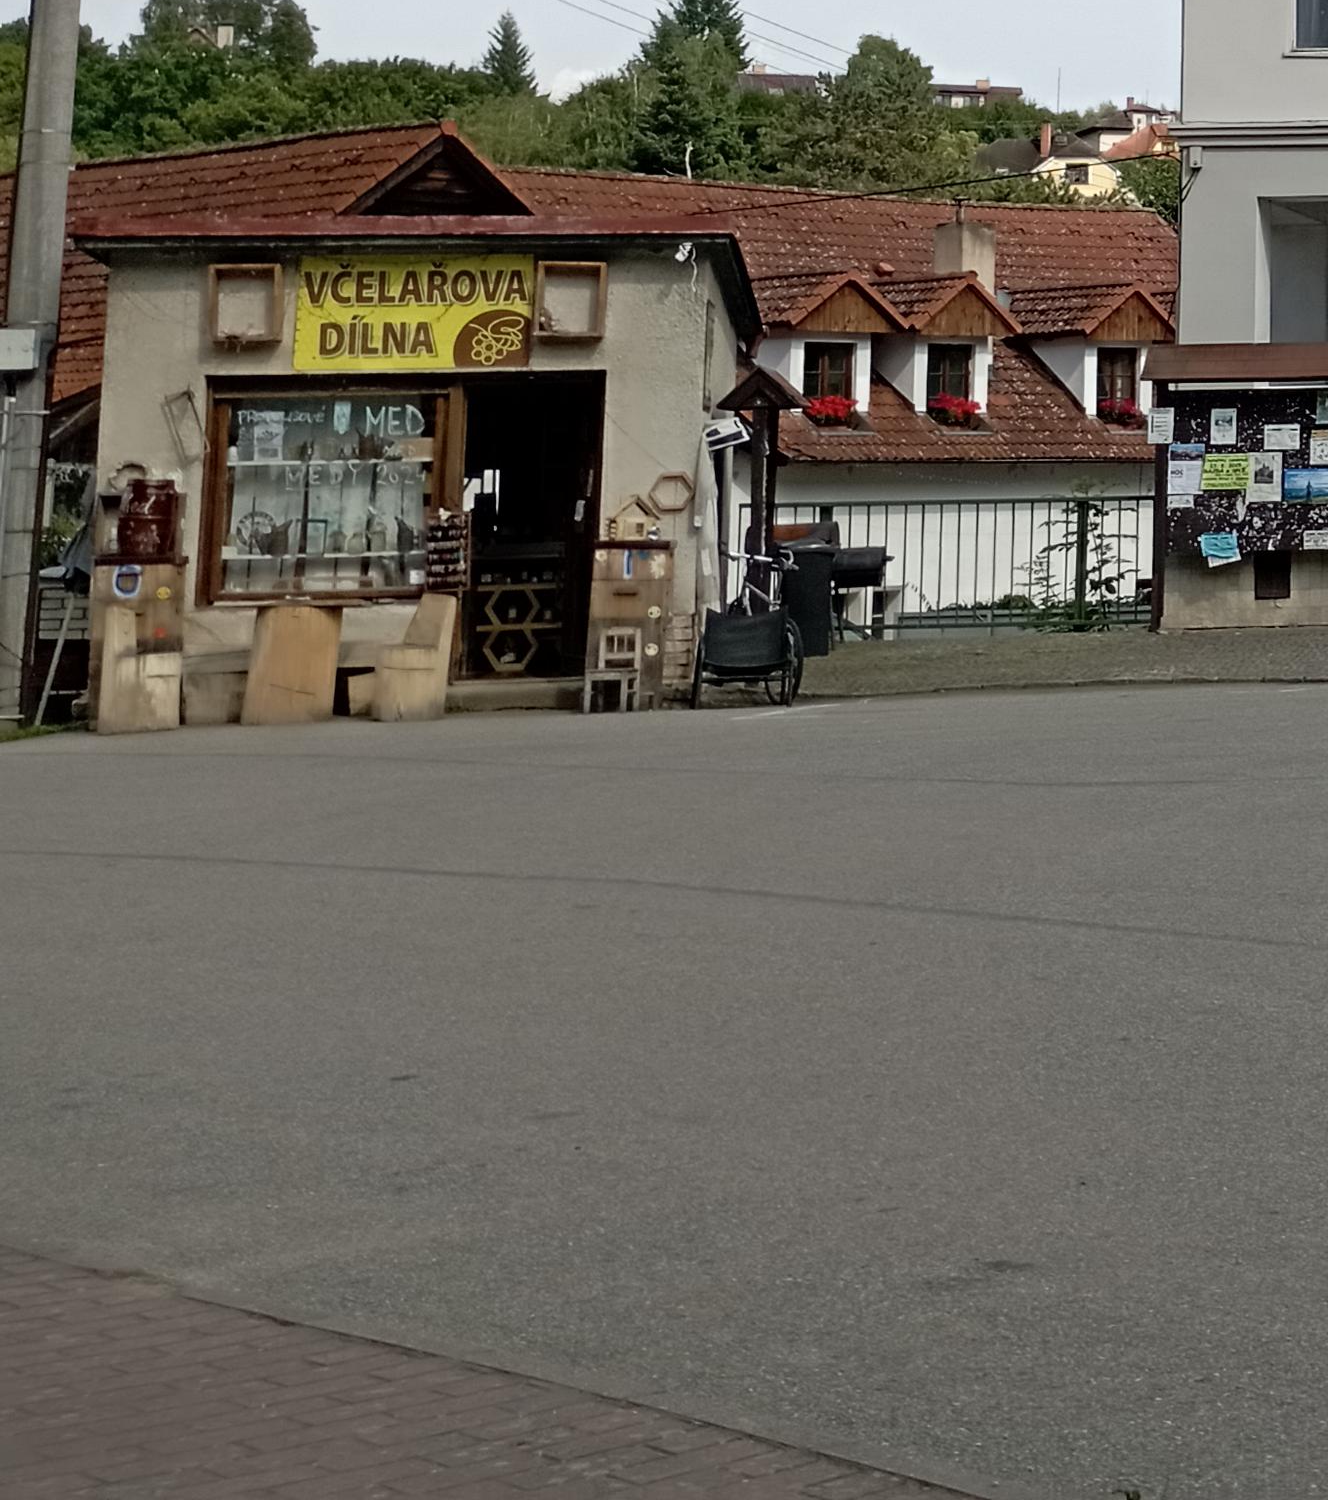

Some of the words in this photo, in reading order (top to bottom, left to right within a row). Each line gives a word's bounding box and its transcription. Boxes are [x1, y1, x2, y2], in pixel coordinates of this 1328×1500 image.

[304, 262, 529, 305] VČELAŘOVA
[318, 314, 436, 357] DÍLNA
[366, 404, 425, 437] MED
[285, 462, 363, 485] MEDY
